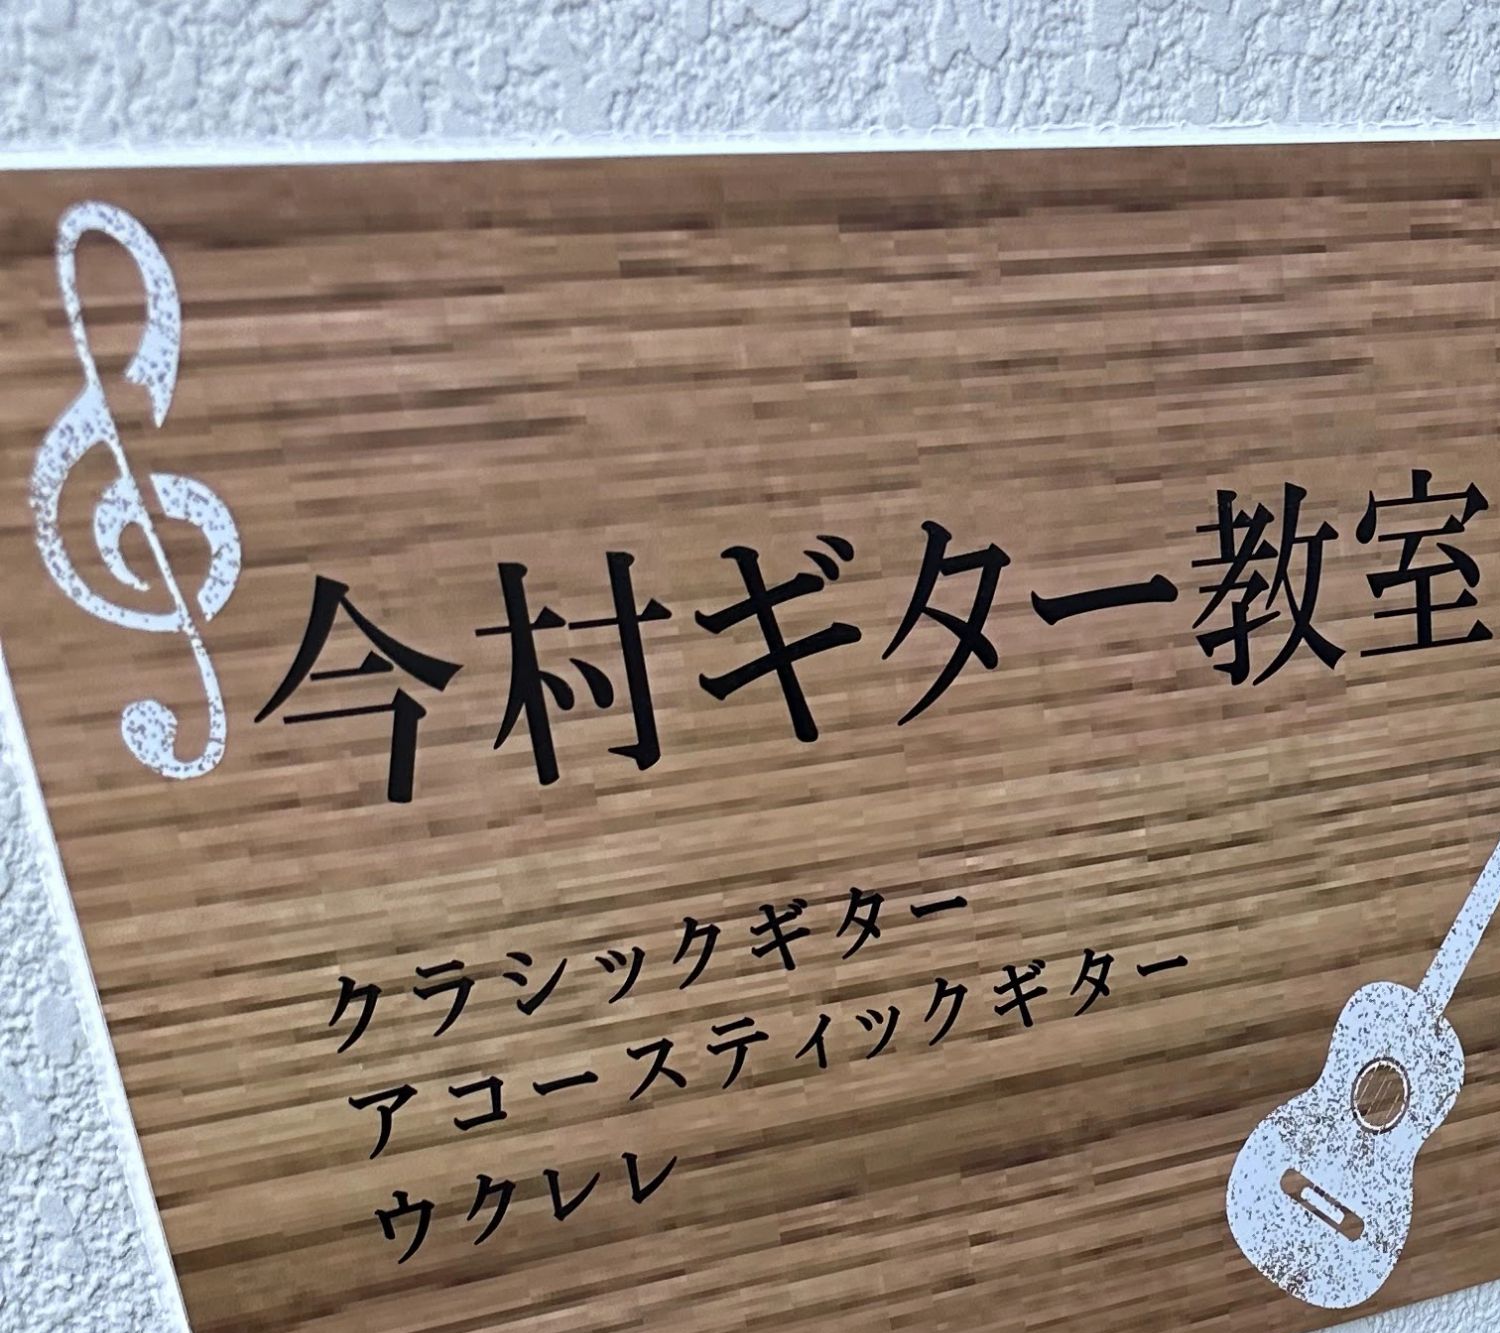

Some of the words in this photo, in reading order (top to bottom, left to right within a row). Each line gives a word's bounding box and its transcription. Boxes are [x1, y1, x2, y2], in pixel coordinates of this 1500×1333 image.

[254, 469, 1494, 804] 今村ギター教室
[328, 887, 969, 1054] クラシックギター
[347, 948, 1189, 1160] アコースティックギター
[374, 1152, 677, 1265] ウクレレ
